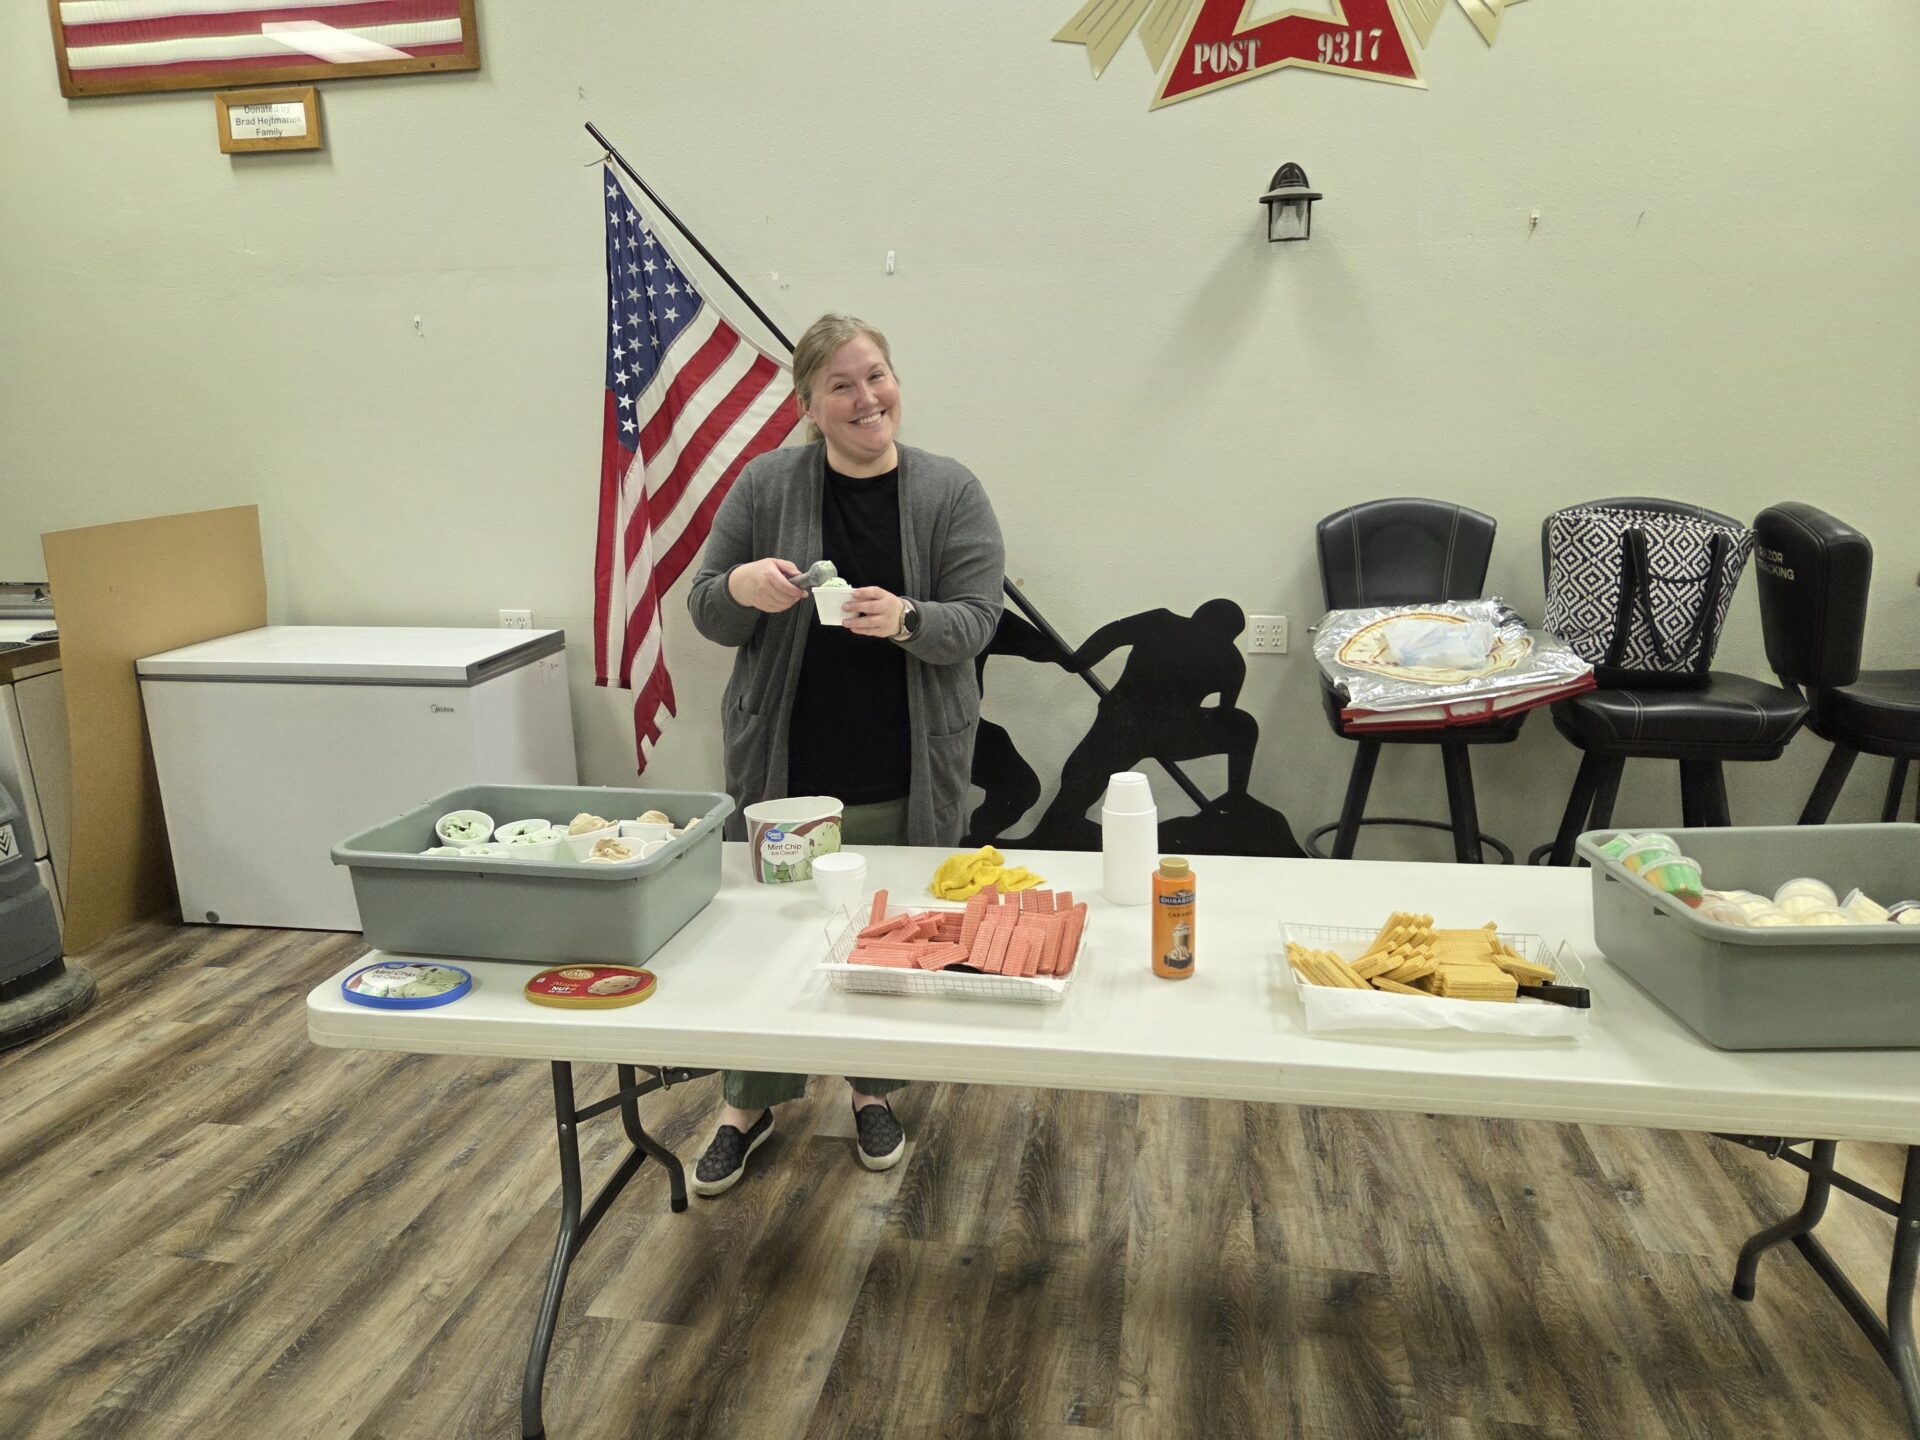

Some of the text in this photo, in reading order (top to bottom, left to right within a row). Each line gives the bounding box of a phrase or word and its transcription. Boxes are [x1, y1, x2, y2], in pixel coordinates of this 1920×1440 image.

[1193, 28, 1383, 74] POST 9317
[244, 104, 279, 114] Donated
[235, 117, 256, 126] Brad
[256, 128, 283, 137] Family
